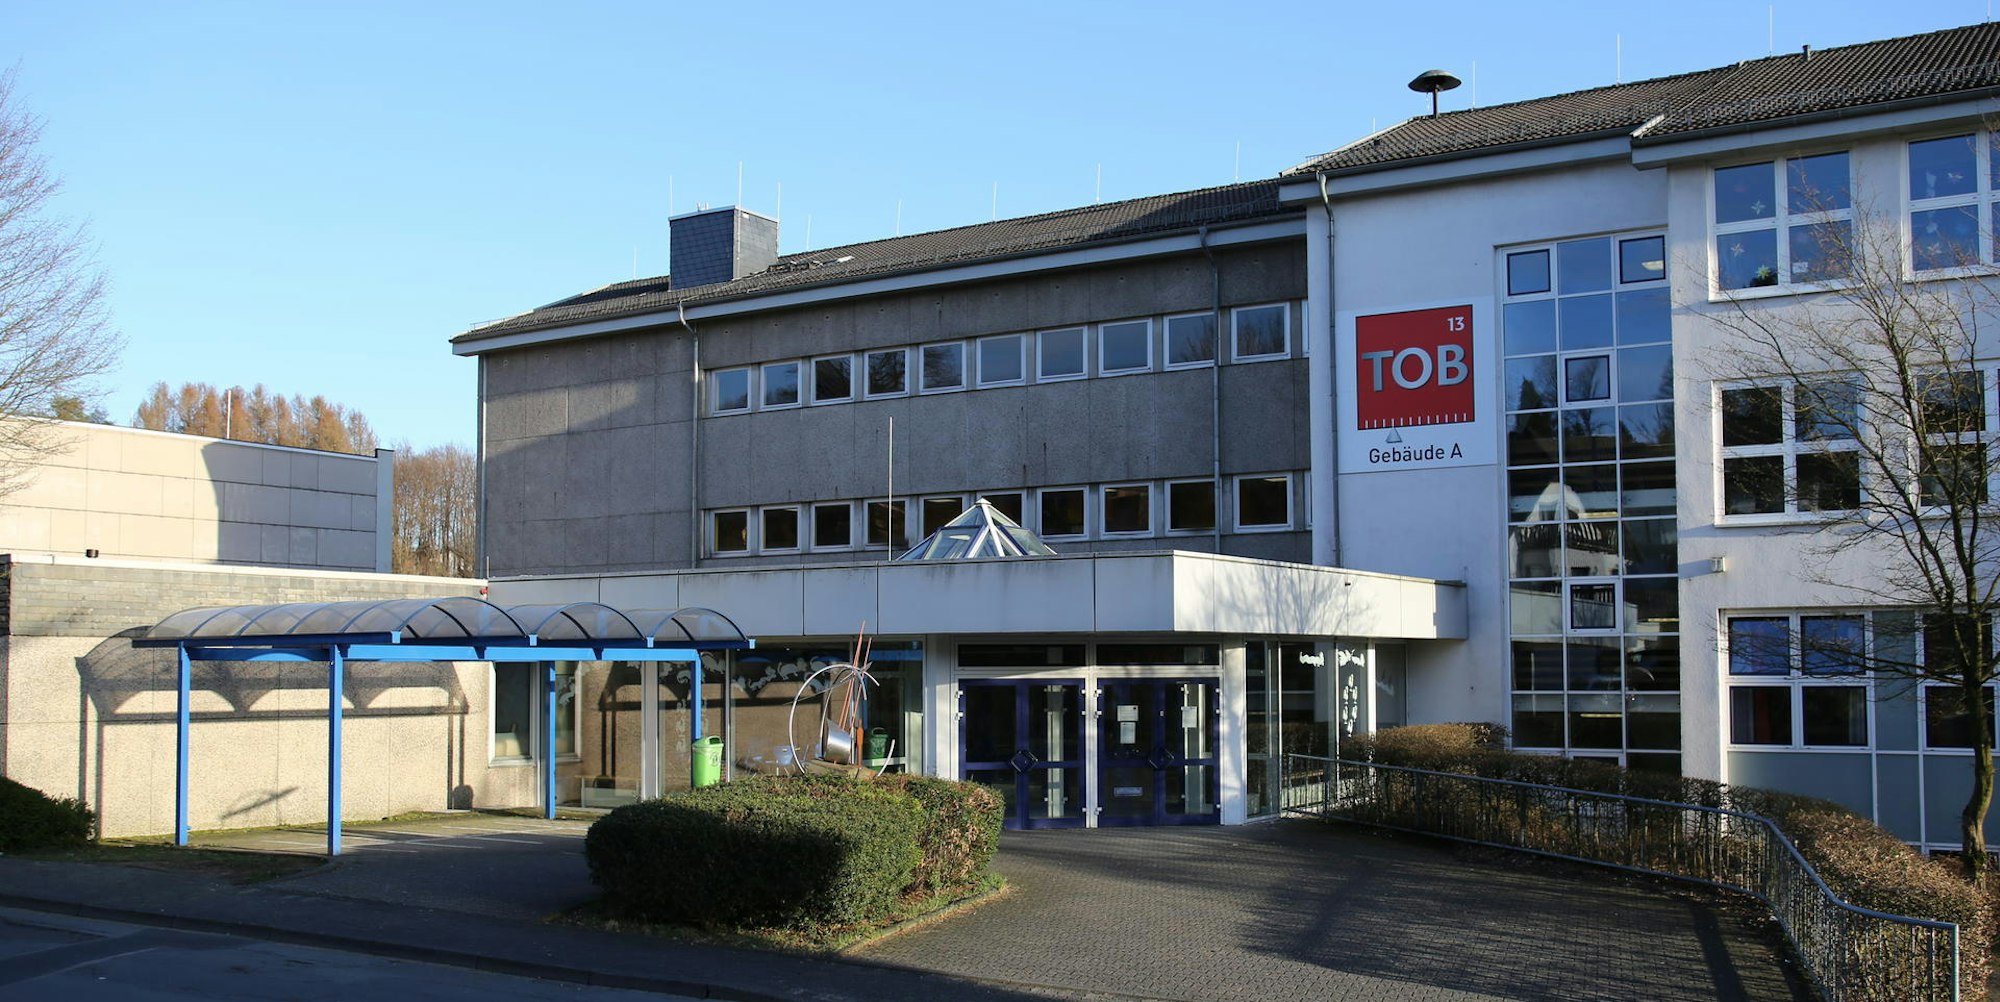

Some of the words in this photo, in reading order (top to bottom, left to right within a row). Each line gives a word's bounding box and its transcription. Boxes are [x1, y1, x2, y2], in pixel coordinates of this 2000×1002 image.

[1447, 316, 1465, 332] 13
[1361, 344, 1469, 392] TOB
[1369, 445, 1445, 464] Gebäude
[1450, 443, 1463, 459] A
